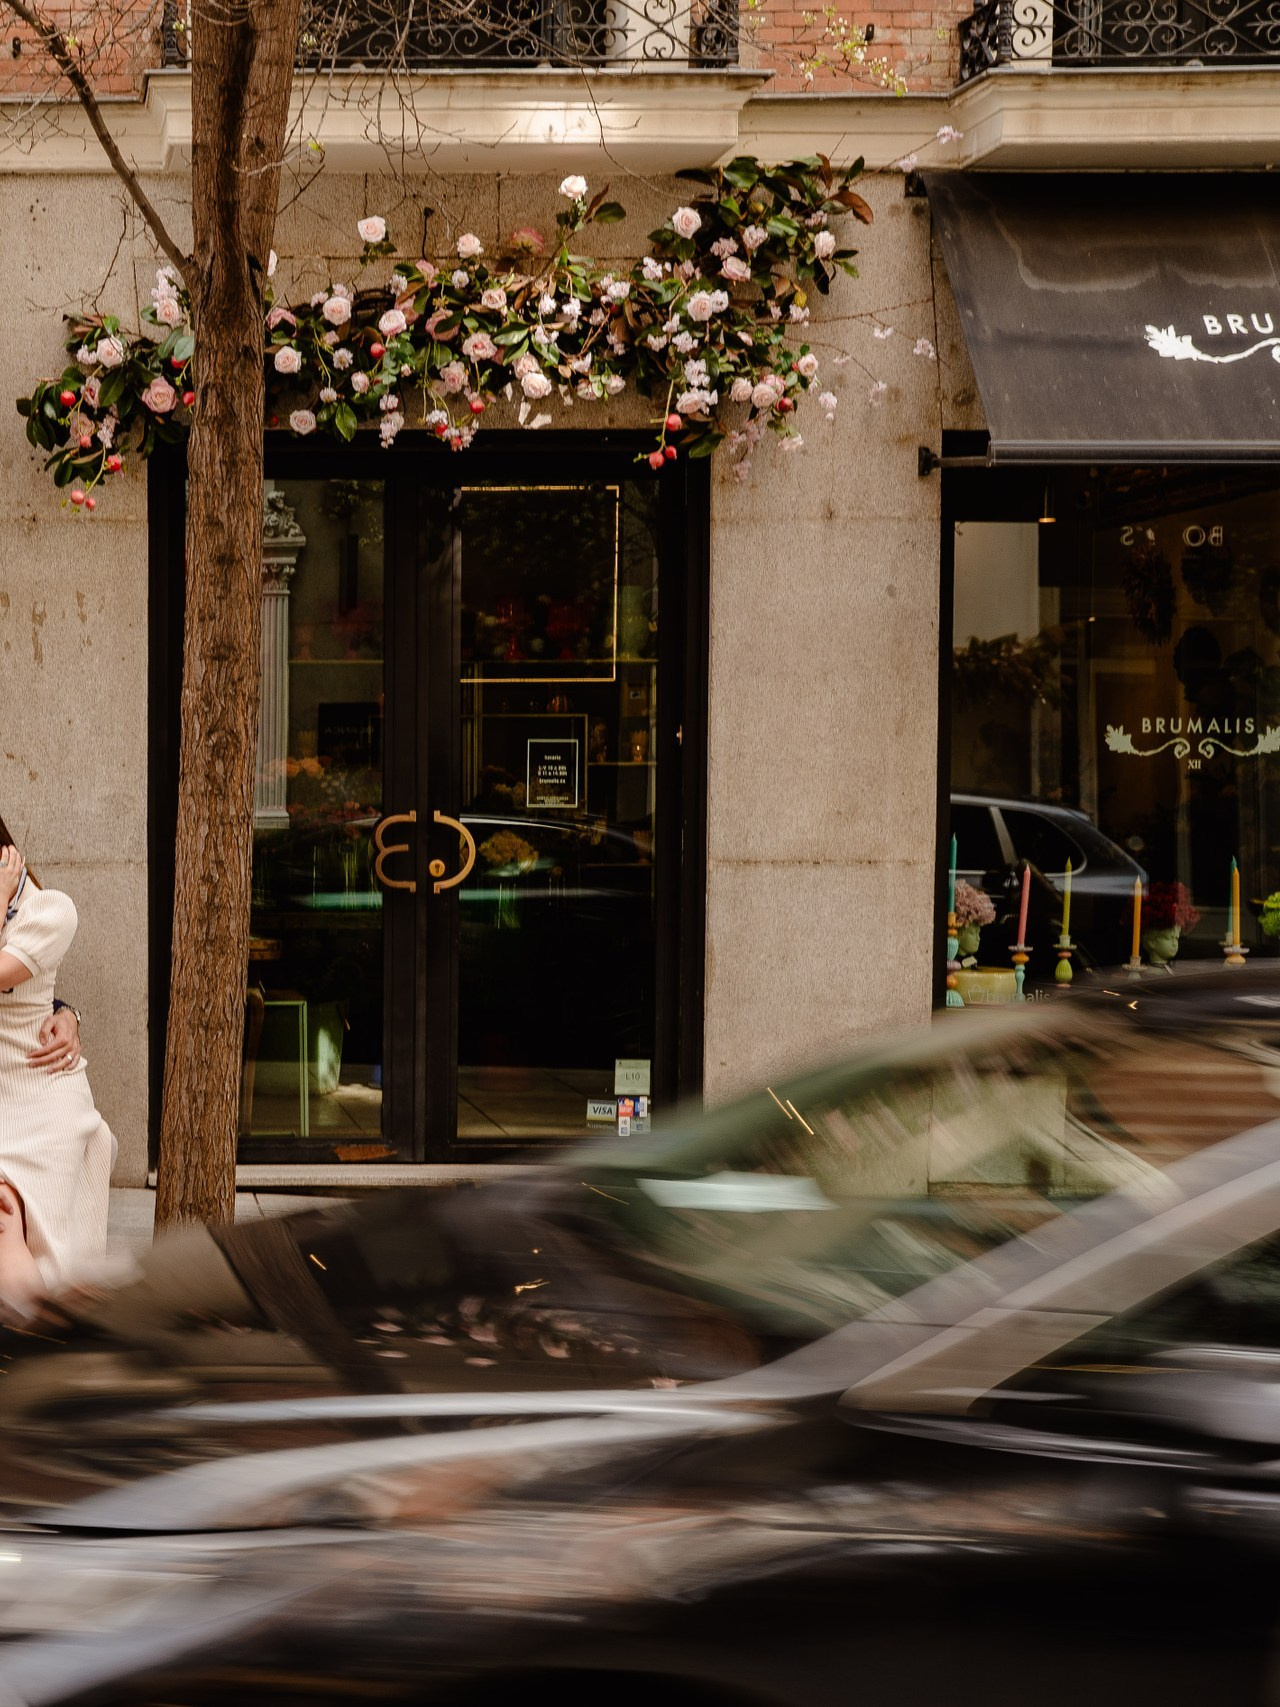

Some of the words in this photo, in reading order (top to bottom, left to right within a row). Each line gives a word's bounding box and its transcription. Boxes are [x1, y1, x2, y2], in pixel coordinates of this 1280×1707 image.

[1141, 717, 1255, 734] BRUMALIS
[1187, 759, 1202, 770] XII
[592, 1106, 613, 1115] VISA
